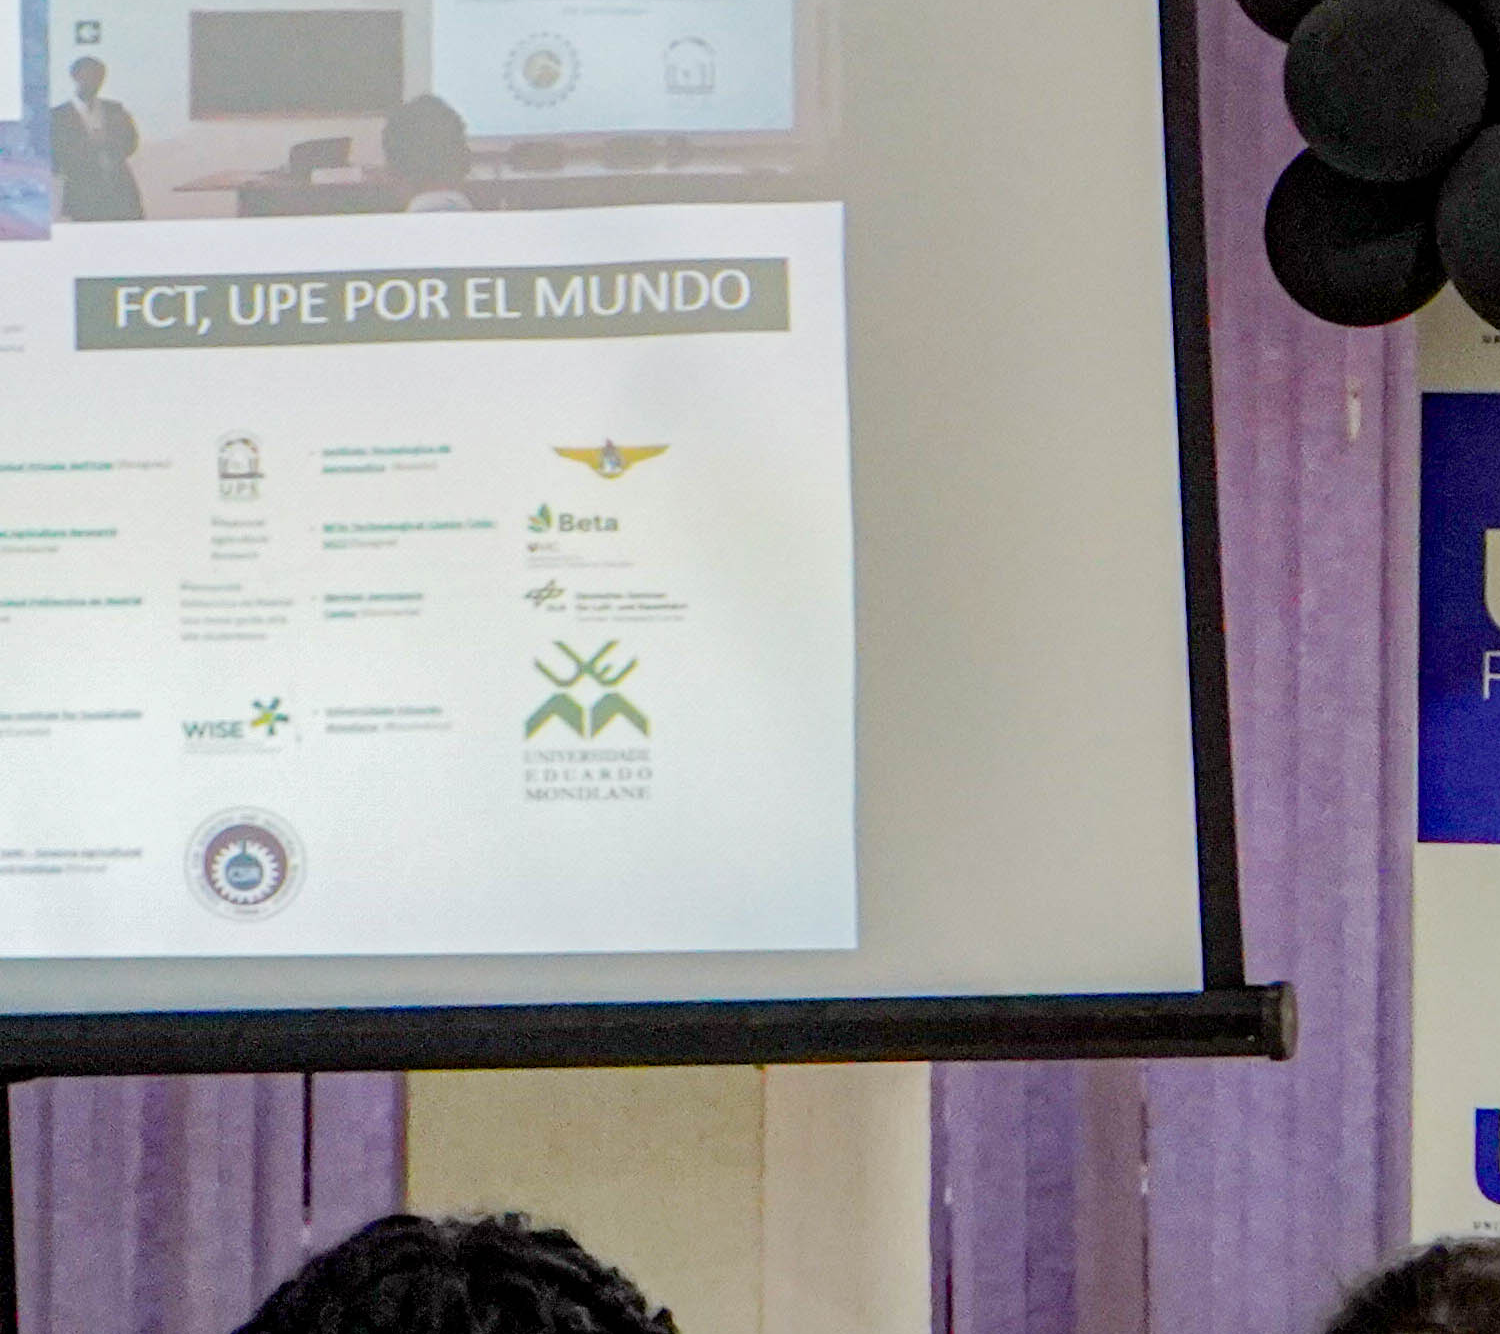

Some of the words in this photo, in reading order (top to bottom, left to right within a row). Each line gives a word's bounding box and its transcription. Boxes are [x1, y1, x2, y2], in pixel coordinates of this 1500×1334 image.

[115, 284, 212, 335] FCT,
[229, 281, 328, 324] UPE
[345, 278, 450, 320] POR
[464, 276, 521, 318] EL
[535, 269, 752, 317] MUNDO
[558, 513, 619, 533] Beta
[183, 721, 244, 739] WISE
[524, 767, 653, 783] EDUARDO
[524, 787, 651, 802] MONDLANE
